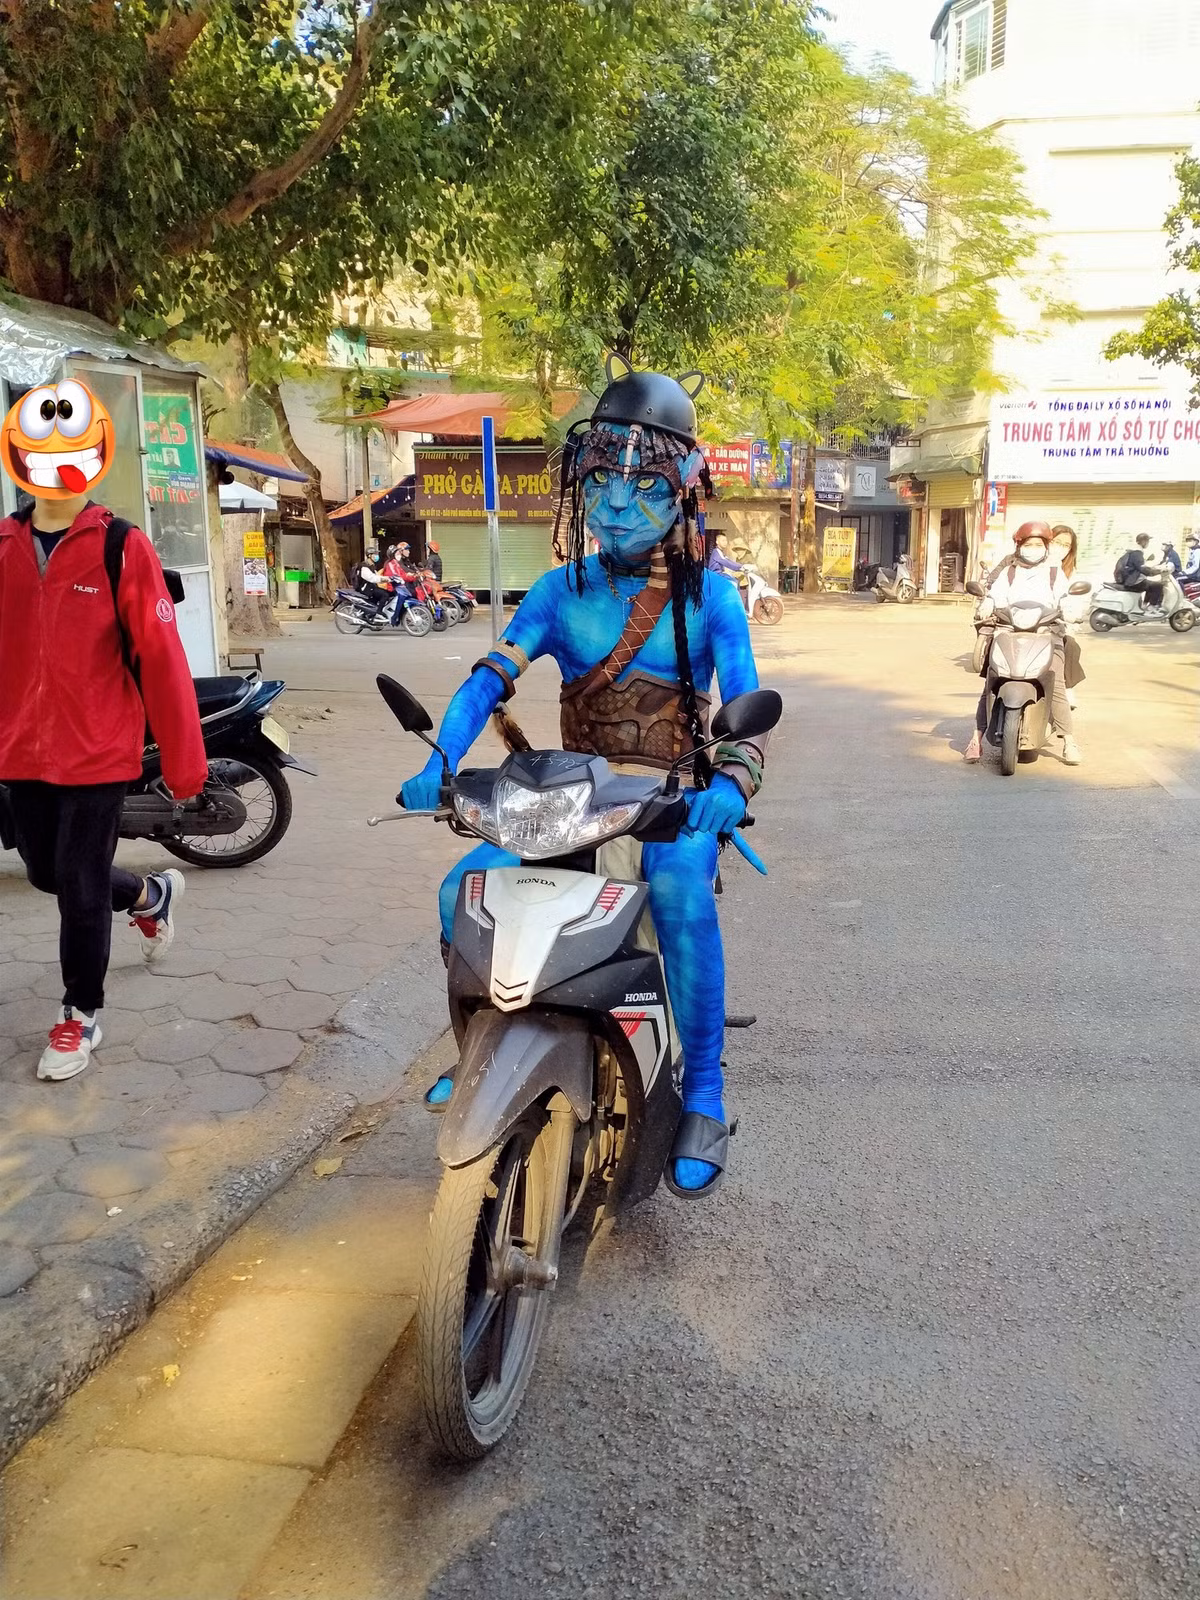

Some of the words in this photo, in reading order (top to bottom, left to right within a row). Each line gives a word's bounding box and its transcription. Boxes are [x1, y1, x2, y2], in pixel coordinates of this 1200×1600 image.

[1003, 422, 1053, 442] TRUNG
[1058, 417, 1091, 442] TÂM
[1122, 412, 1143, 441] SỐ
[1148, 418, 1169, 445] TỰ
[1043, 447, 1076, 458] TRUNG
[1080, 445, 1102, 457] TÂM
[718, 462, 729, 472] XE
[423, 466, 457, 494] PHỞ
[461, 469, 485, 494] GÀ
[73, 584, 99, 594] HUST
[516, 878, 557, 888] HONDA
[624, 992, 658, 1003] HONDA
